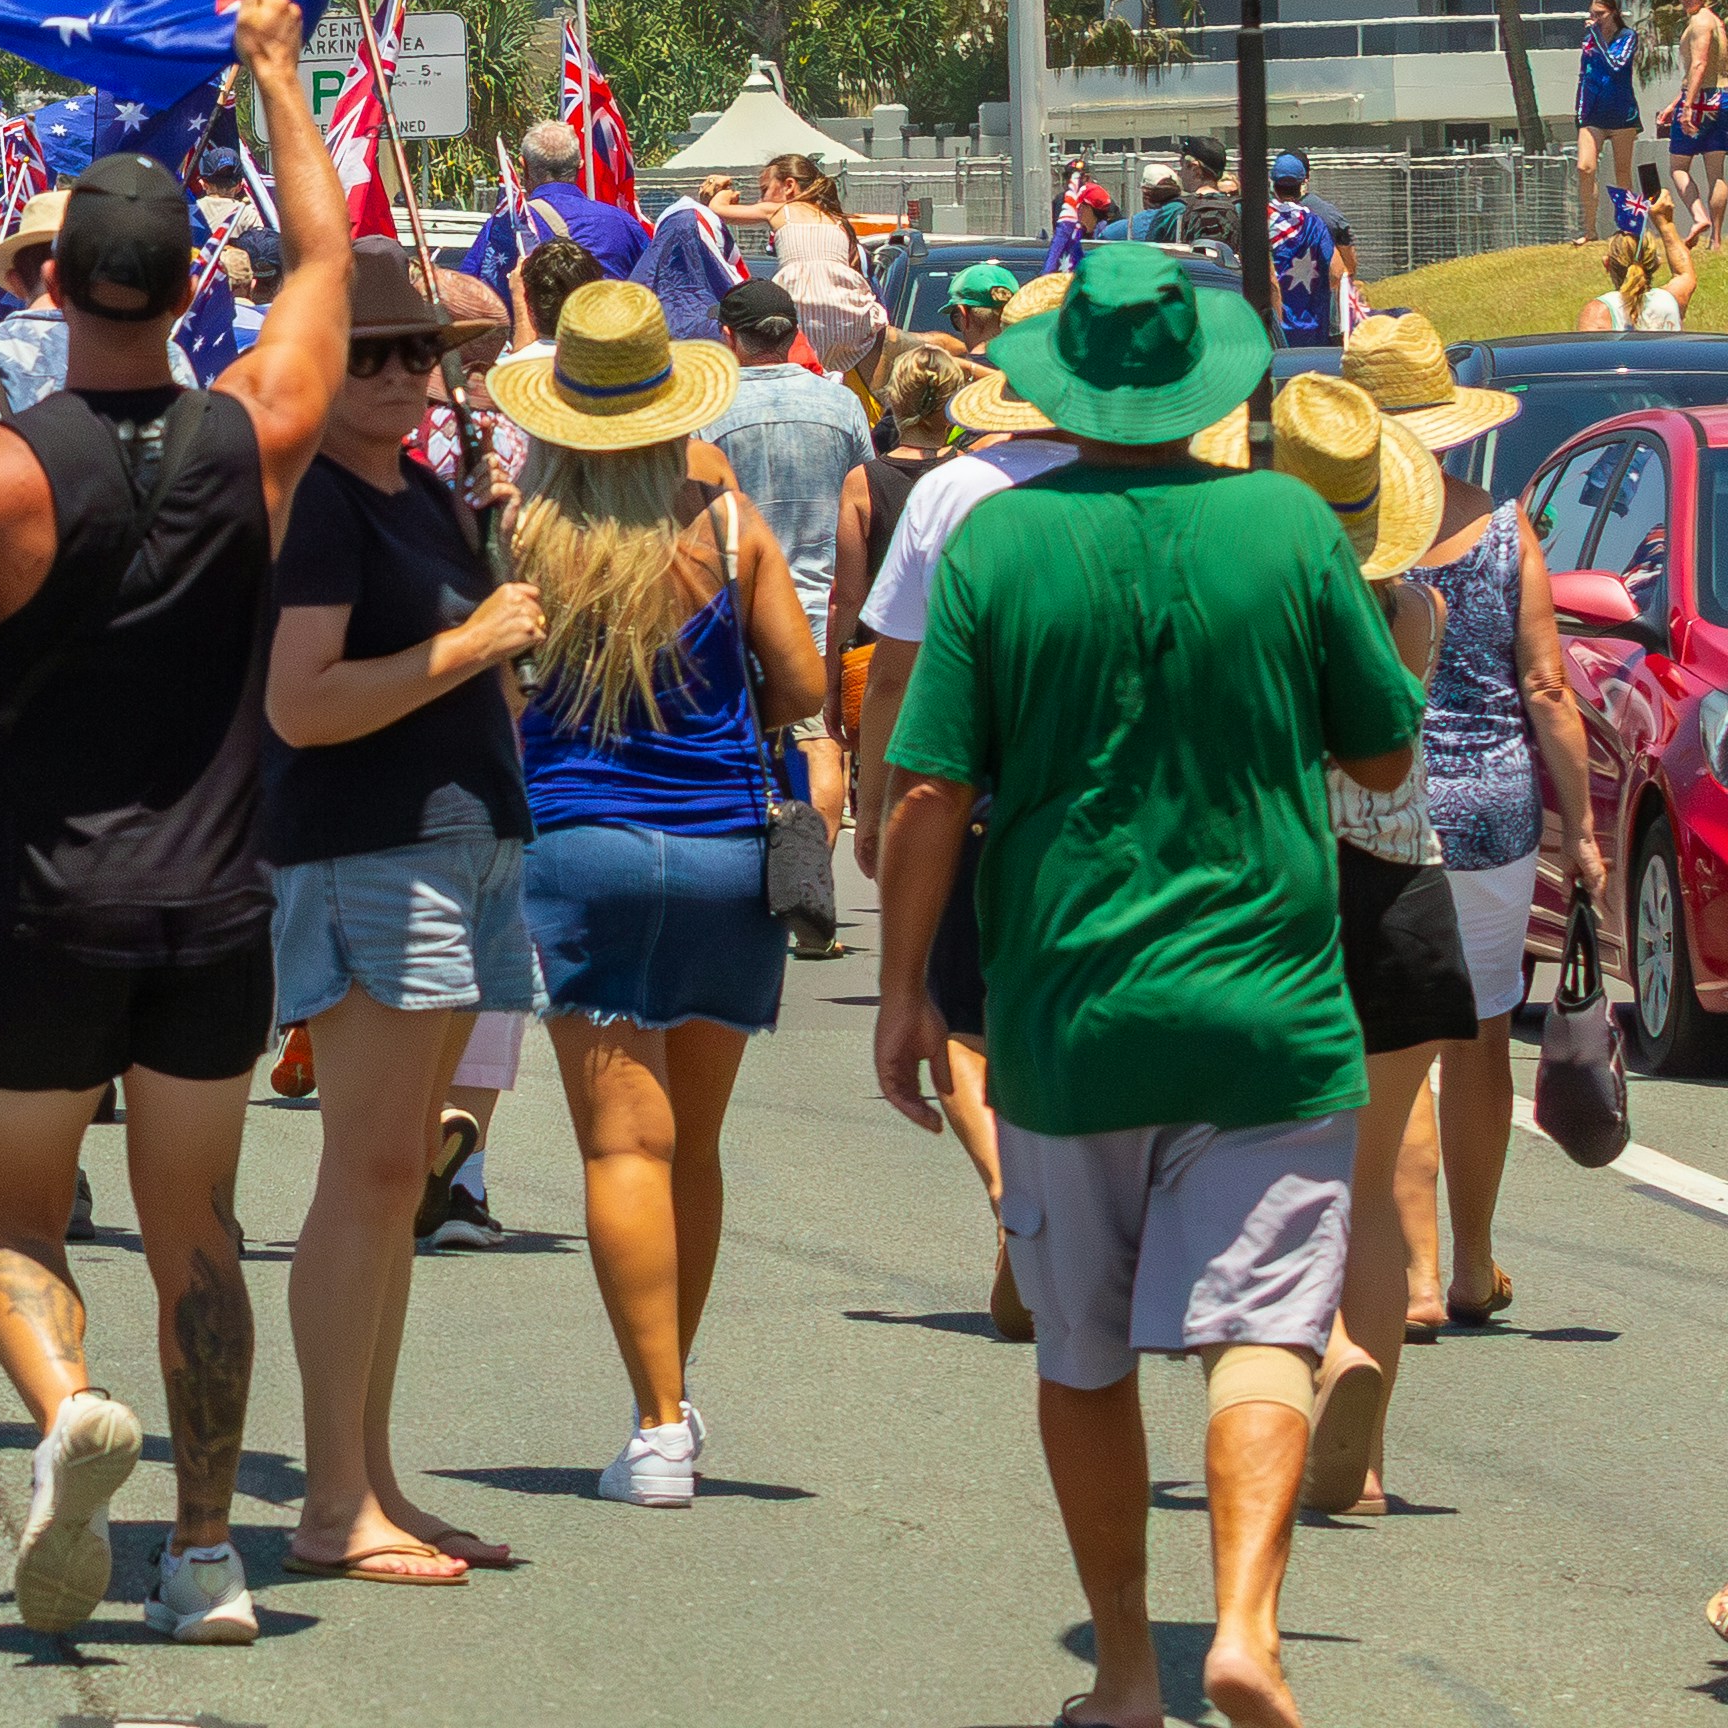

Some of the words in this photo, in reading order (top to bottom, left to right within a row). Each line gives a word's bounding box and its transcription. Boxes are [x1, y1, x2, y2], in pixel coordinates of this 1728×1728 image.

[316, 22, 363, 38] CENT
[304, 38, 363, 55] ARKIN
[402, 37, 425, 52] EA
